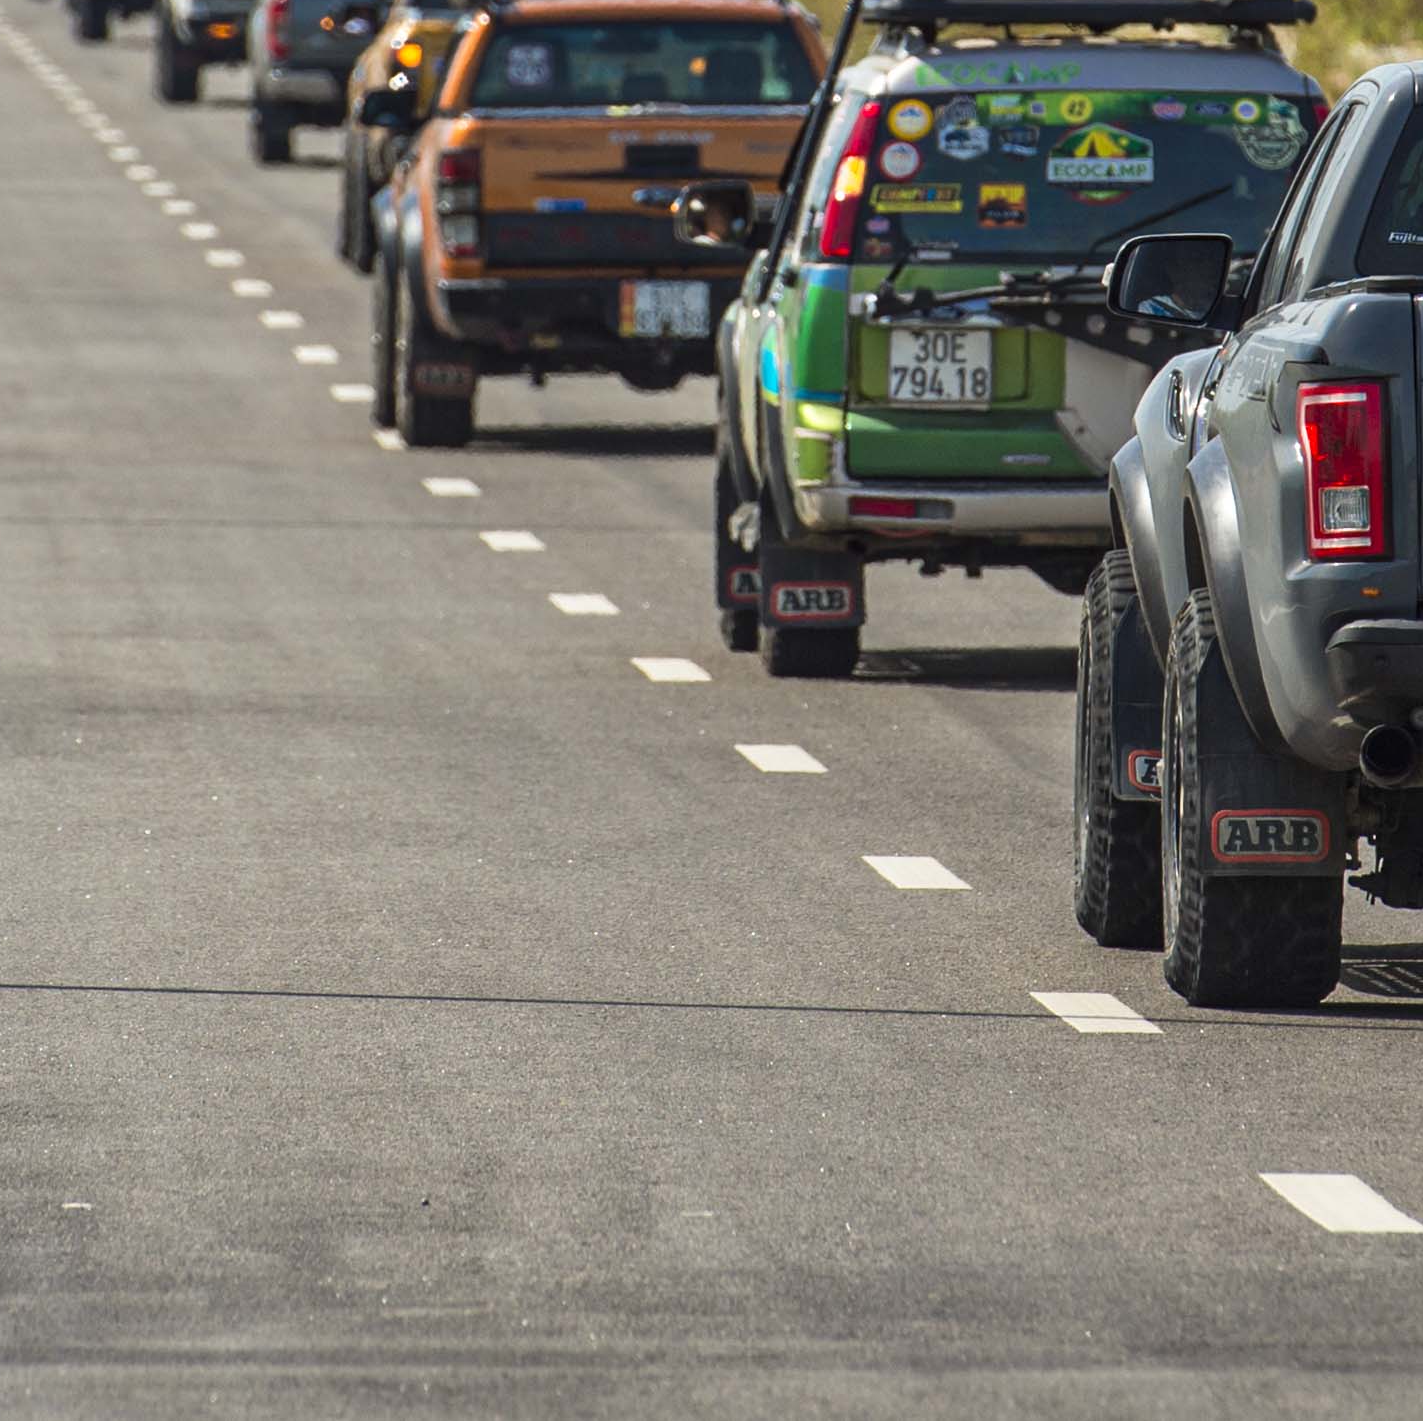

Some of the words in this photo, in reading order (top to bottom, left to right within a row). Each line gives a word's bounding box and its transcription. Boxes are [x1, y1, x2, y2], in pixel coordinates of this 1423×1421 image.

[1053, 161, 1147, 178] ECOCAMP
[911, 331, 968, 363] 30E
[892, 366, 987, 398] 794.18
[782, 589, 846, 611] ARB
[1223, 819, 1320, 853] ARB
